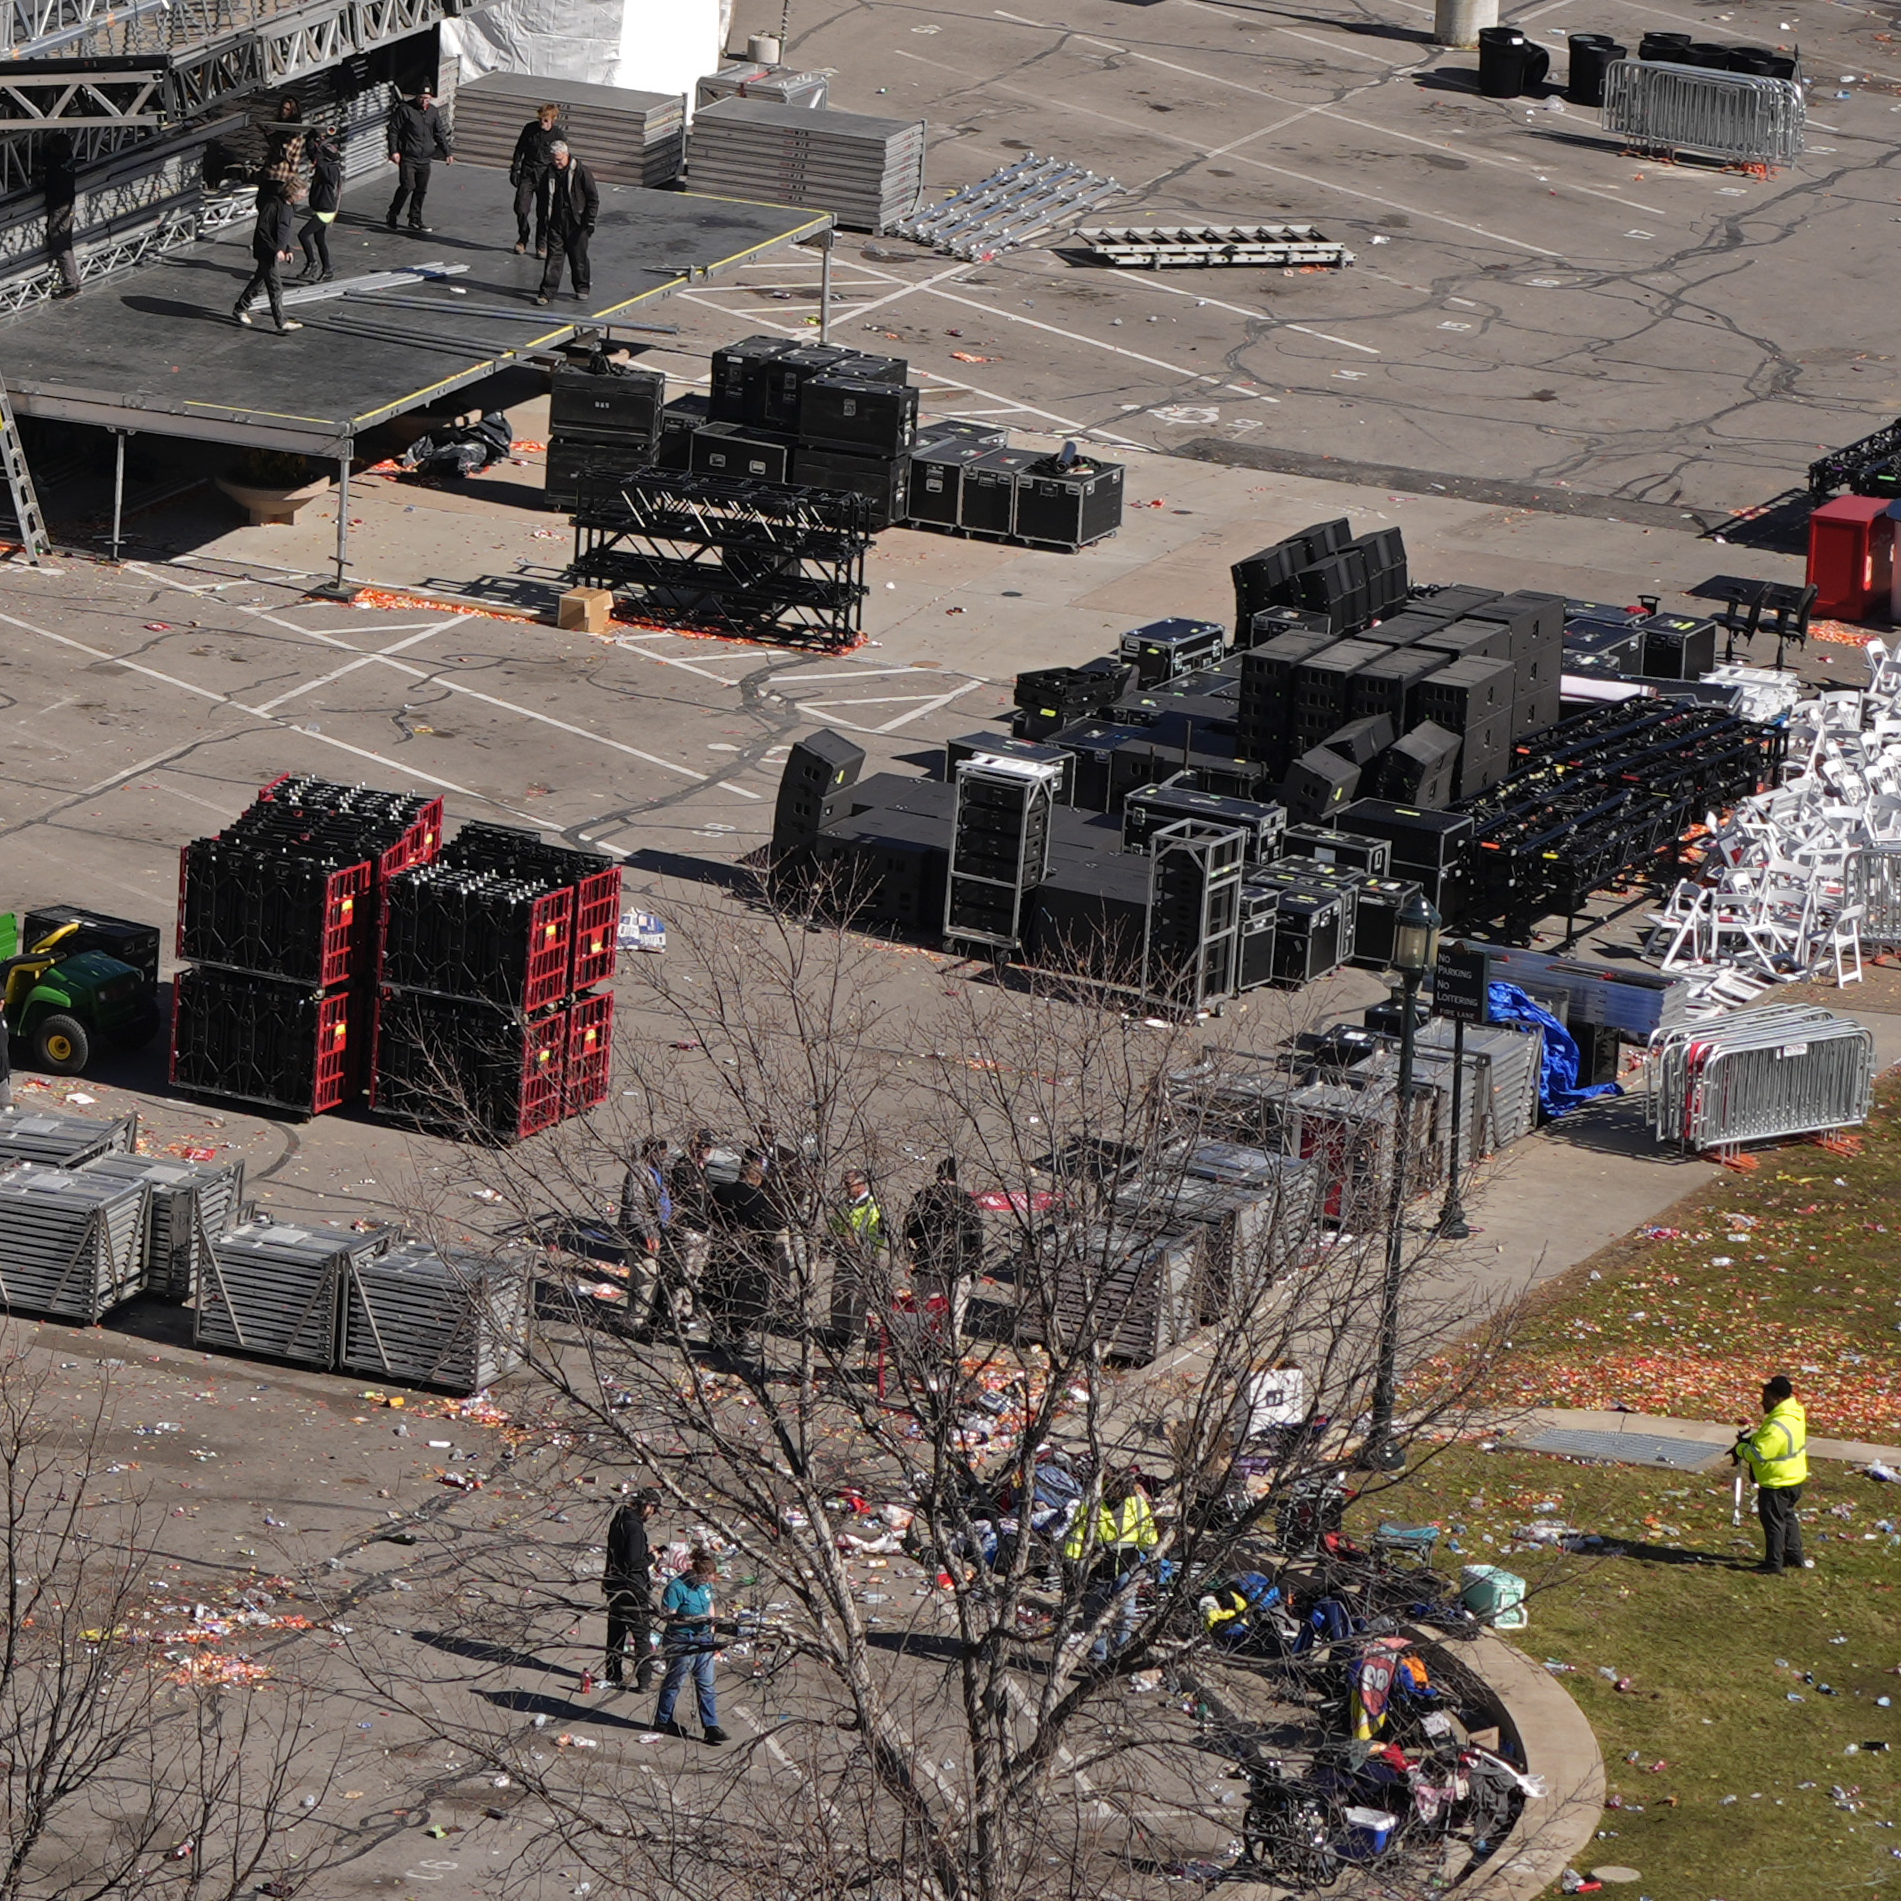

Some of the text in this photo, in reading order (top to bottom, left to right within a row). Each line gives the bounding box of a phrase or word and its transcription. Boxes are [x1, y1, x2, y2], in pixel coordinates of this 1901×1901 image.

[1438, 953, 1451, 965] NO
[1438, 965, 1472, 980] PARKING
[1437, 979, 1450, 991] NO
[1437, 991, 1479, 1007] LOITERING
[1439, 1006, 1474, 1020] FIRE LANE
